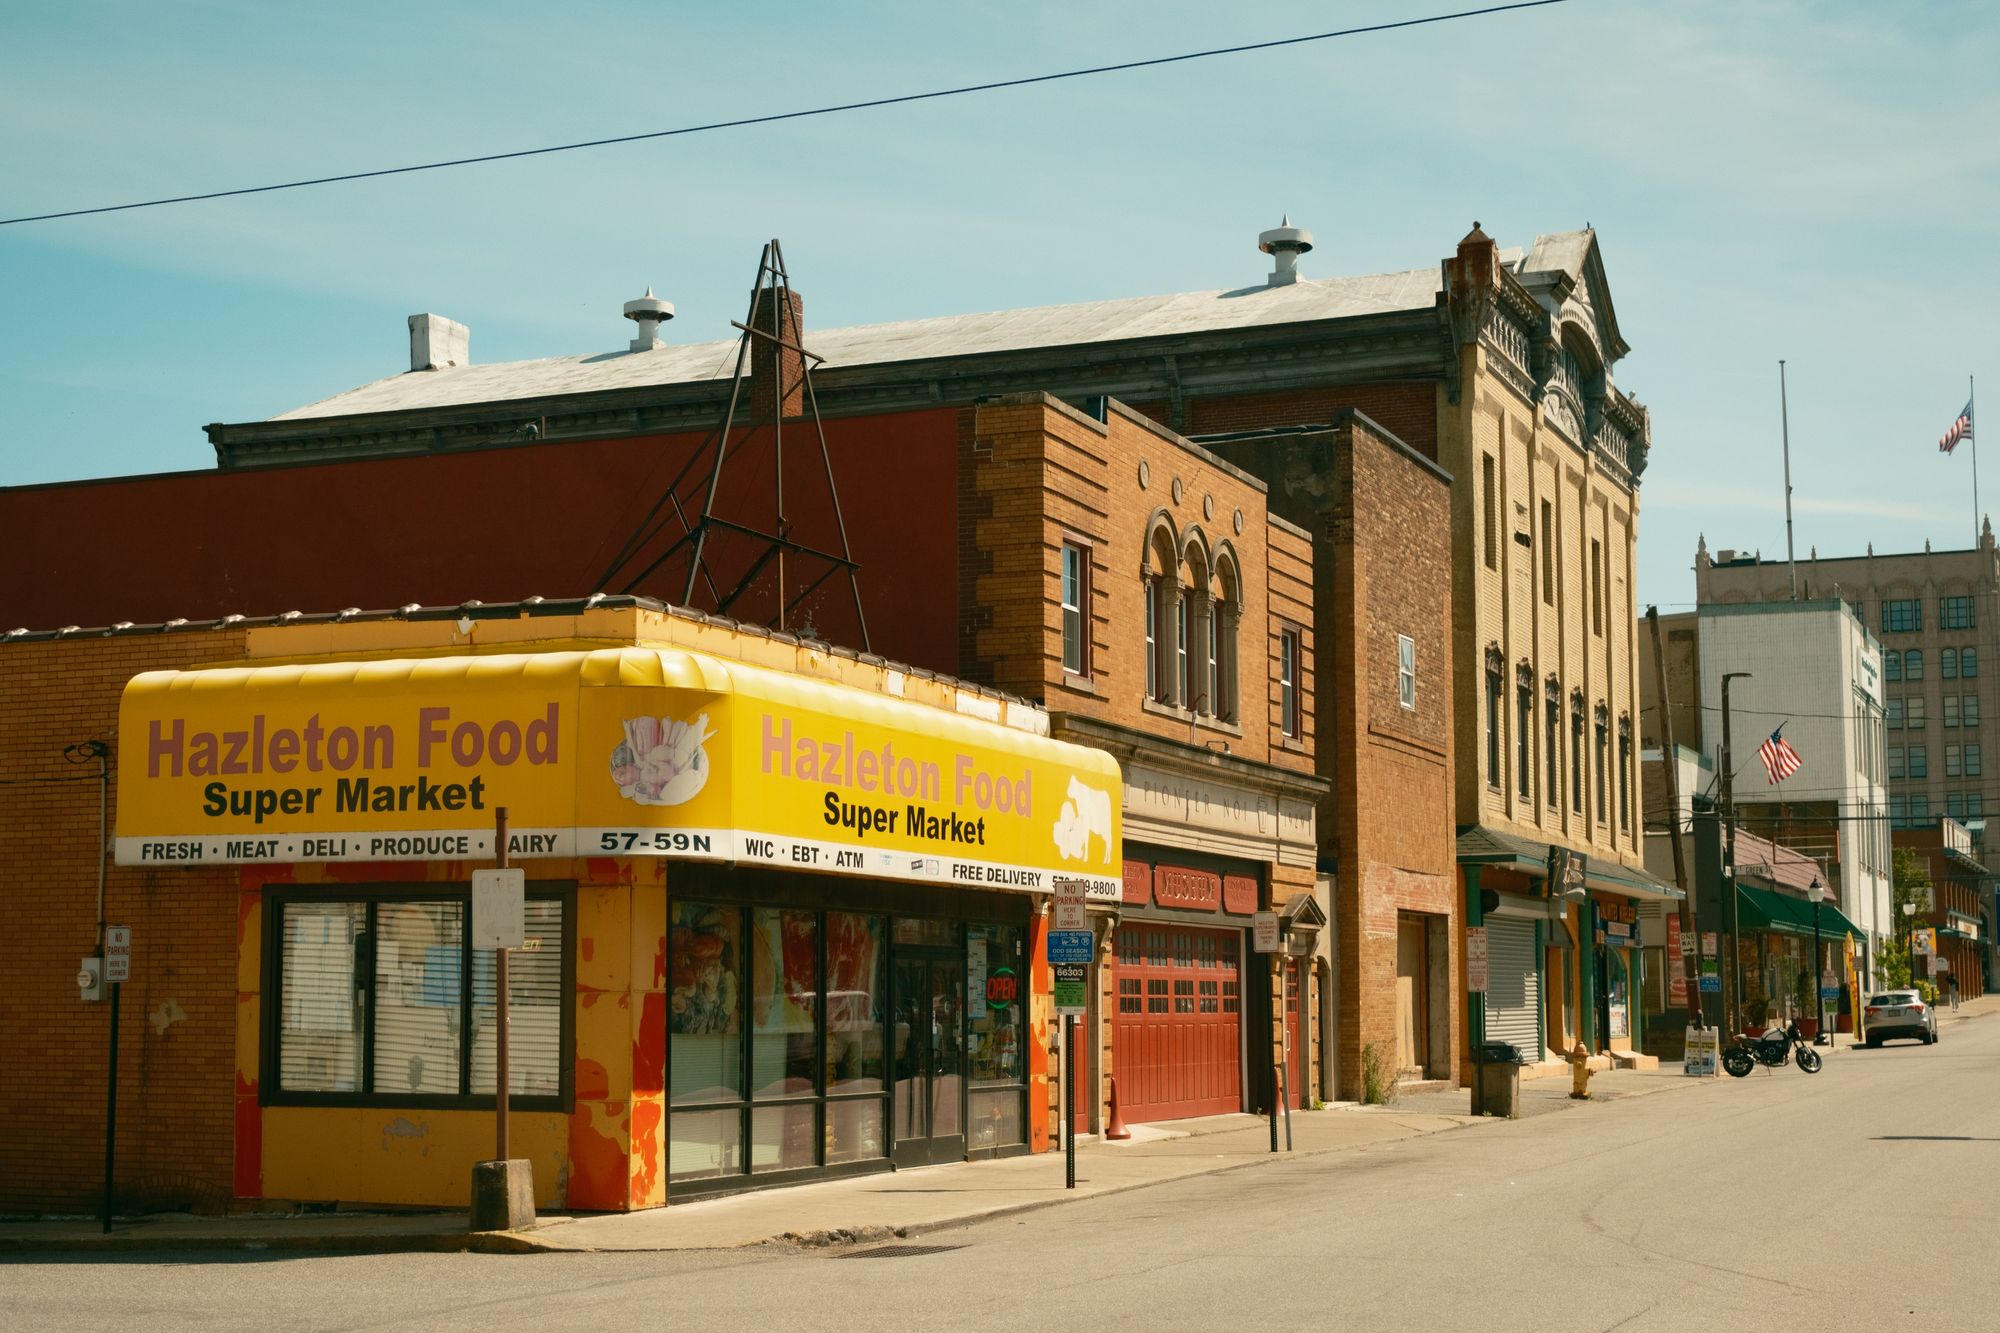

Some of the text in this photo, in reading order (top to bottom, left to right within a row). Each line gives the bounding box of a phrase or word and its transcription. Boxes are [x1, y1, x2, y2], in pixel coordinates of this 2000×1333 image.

[148, 702, 560, 778] Hazleton Food
[762, 714, 1032, 818] Hazleton Food
[203, 775, 485, 824] Super Market
[1144, 781, 1210, 815] PIONEER
[824, 791, 985, 845] Super Market
[142, 834, 558, 860] FRESH MEAT DELI PRODUCE AIRY
[745, 837, 774, 858] WIC
[792, 845, 819, 864] EBT
[836, 850, 864, 868] ATM
[952, 863, 1041, 887] FREE DELIVERY
[1162, 871, 1216, 901] MUSEUM
[1056, 896, 1085, 905] PARKING
[1064, 885, 1076, 894] NO
[480, 898, 518, 916] WAY
[114, 933, 124, 942] NO
[1057, 968, 1084, 976] 66303
[987, 977, 1017, 1000] OPEN
